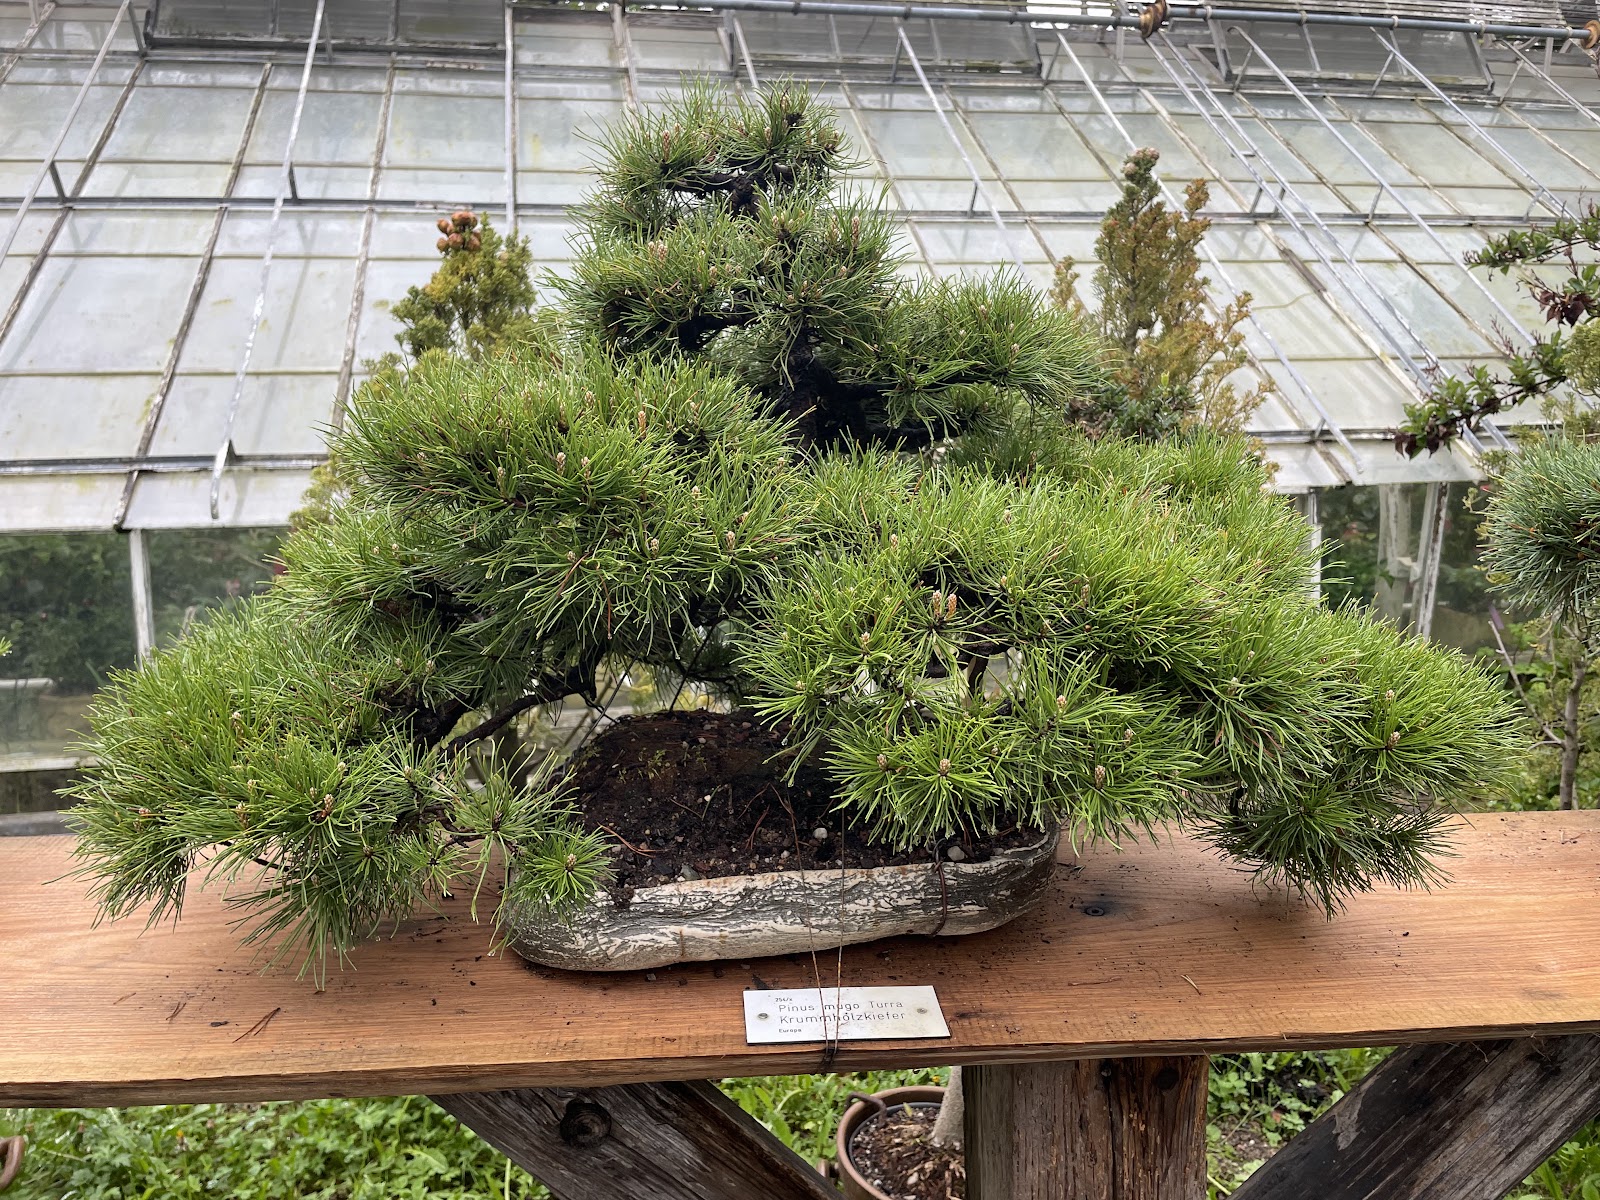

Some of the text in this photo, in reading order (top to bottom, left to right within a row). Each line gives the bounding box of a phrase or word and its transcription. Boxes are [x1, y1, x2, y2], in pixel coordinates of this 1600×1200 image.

[778, 1000, 904, 1012] Pinus mugo Turra
